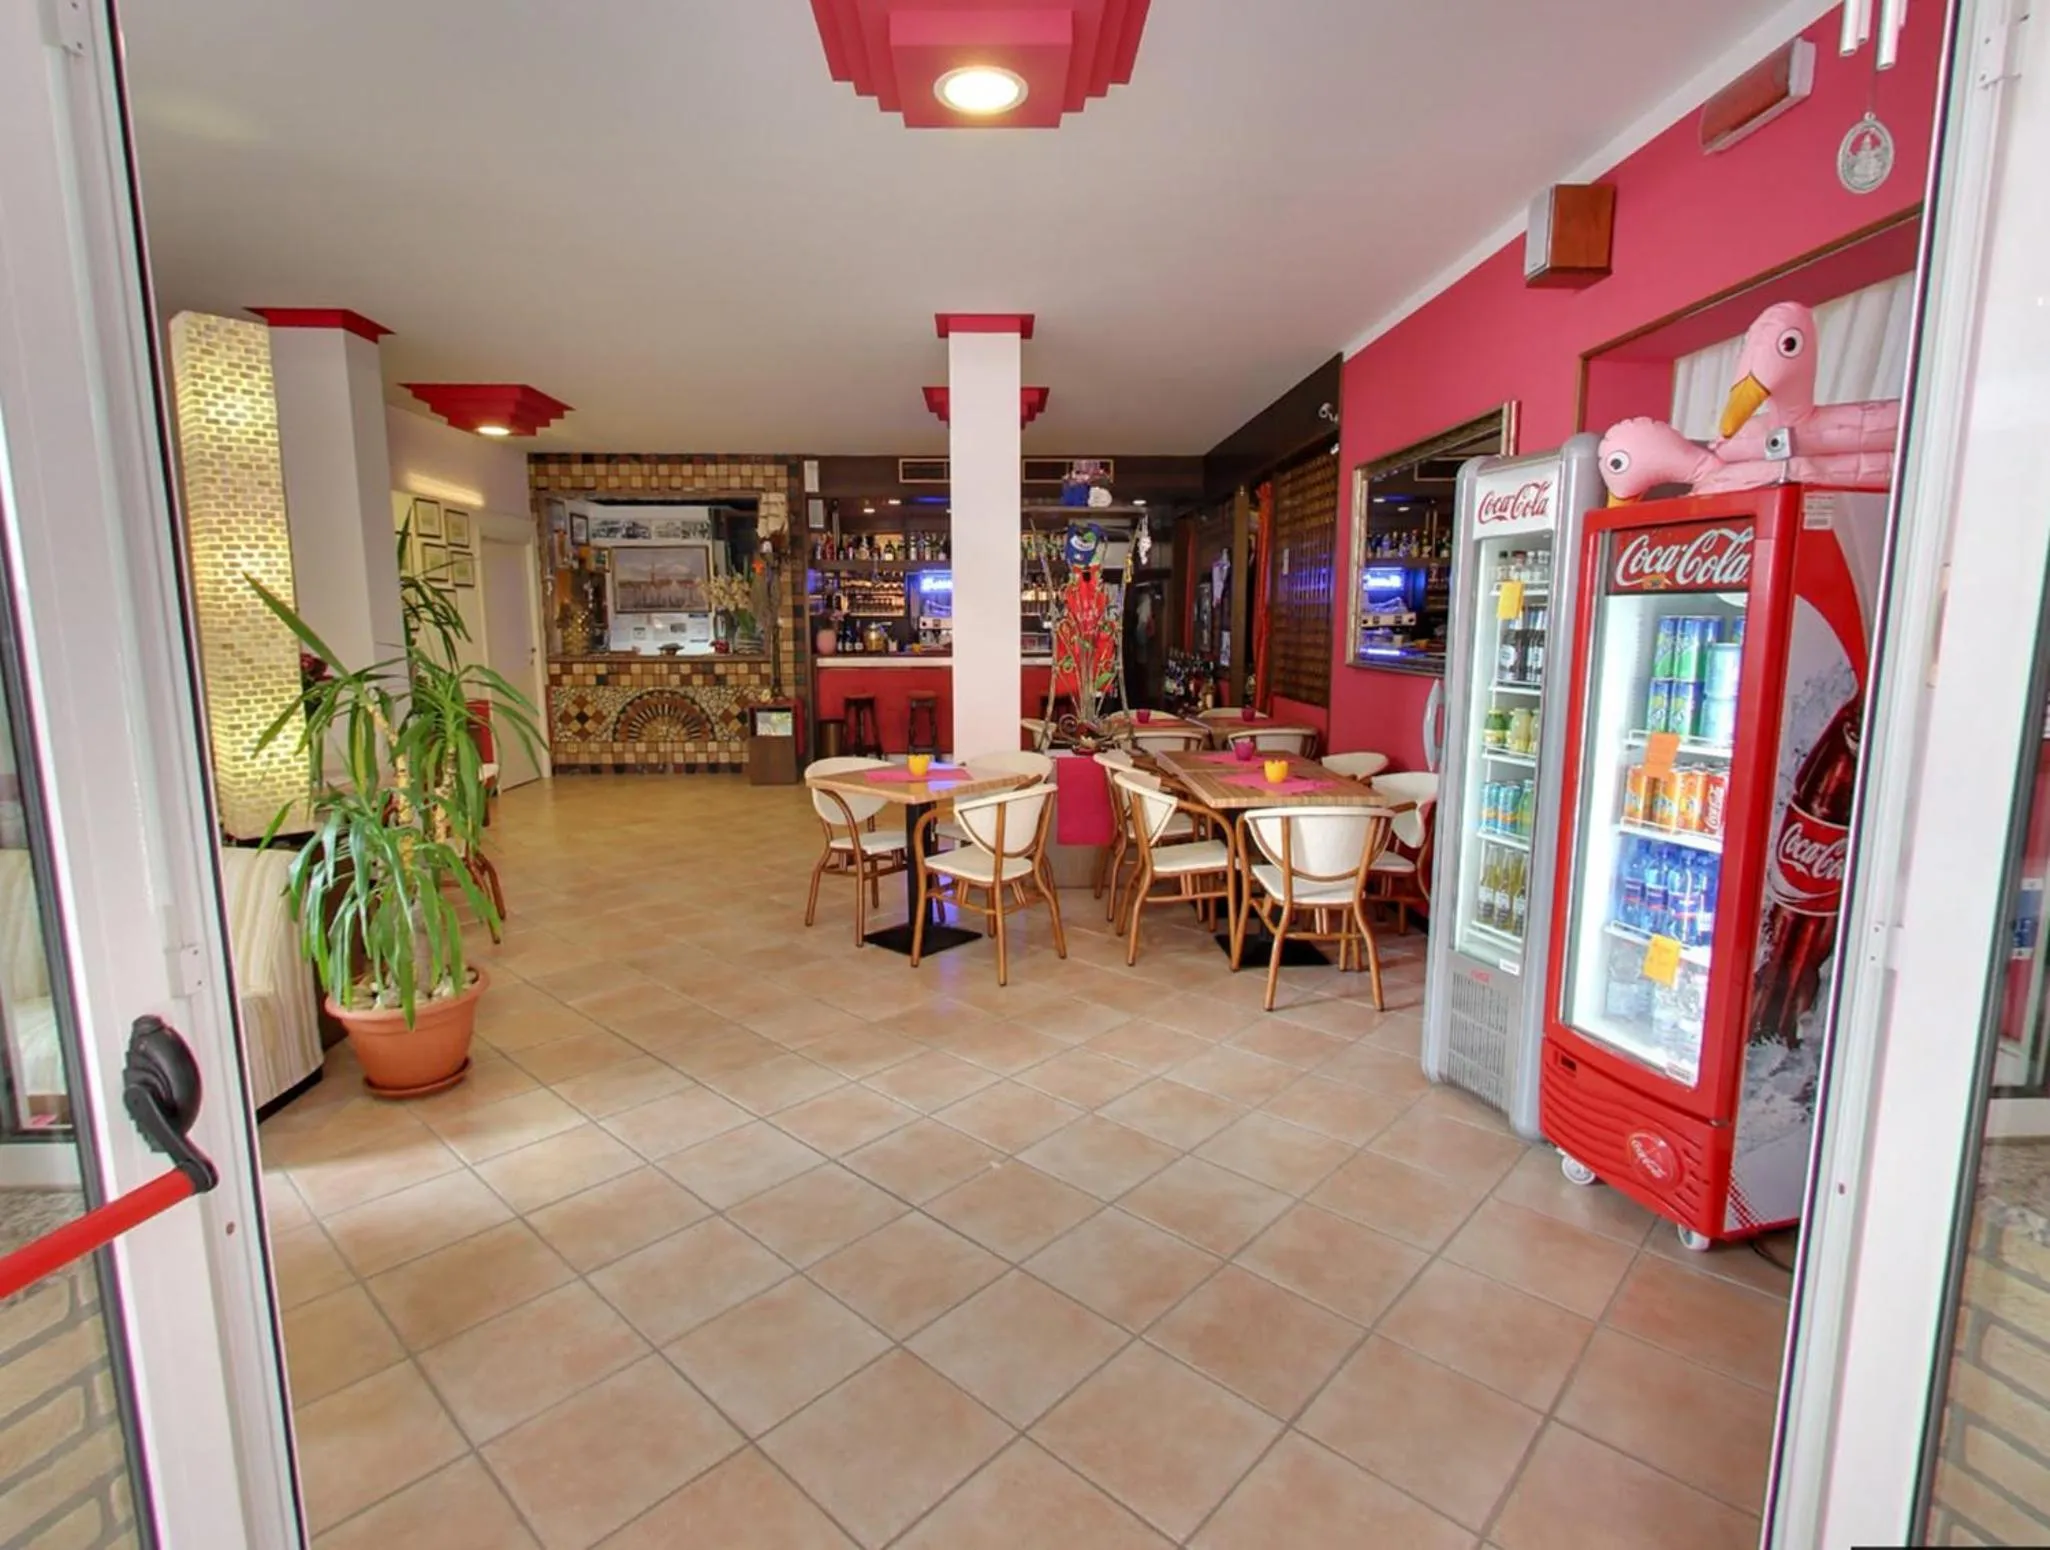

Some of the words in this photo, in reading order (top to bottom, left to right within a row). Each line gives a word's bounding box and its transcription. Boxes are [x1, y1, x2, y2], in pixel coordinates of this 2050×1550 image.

[1478, 481, 1552, 525] Coca-Cola
[1615, 526, 1754, 586] Coca-Cola
[1778, 822, 1848, 880] Coca-Co
